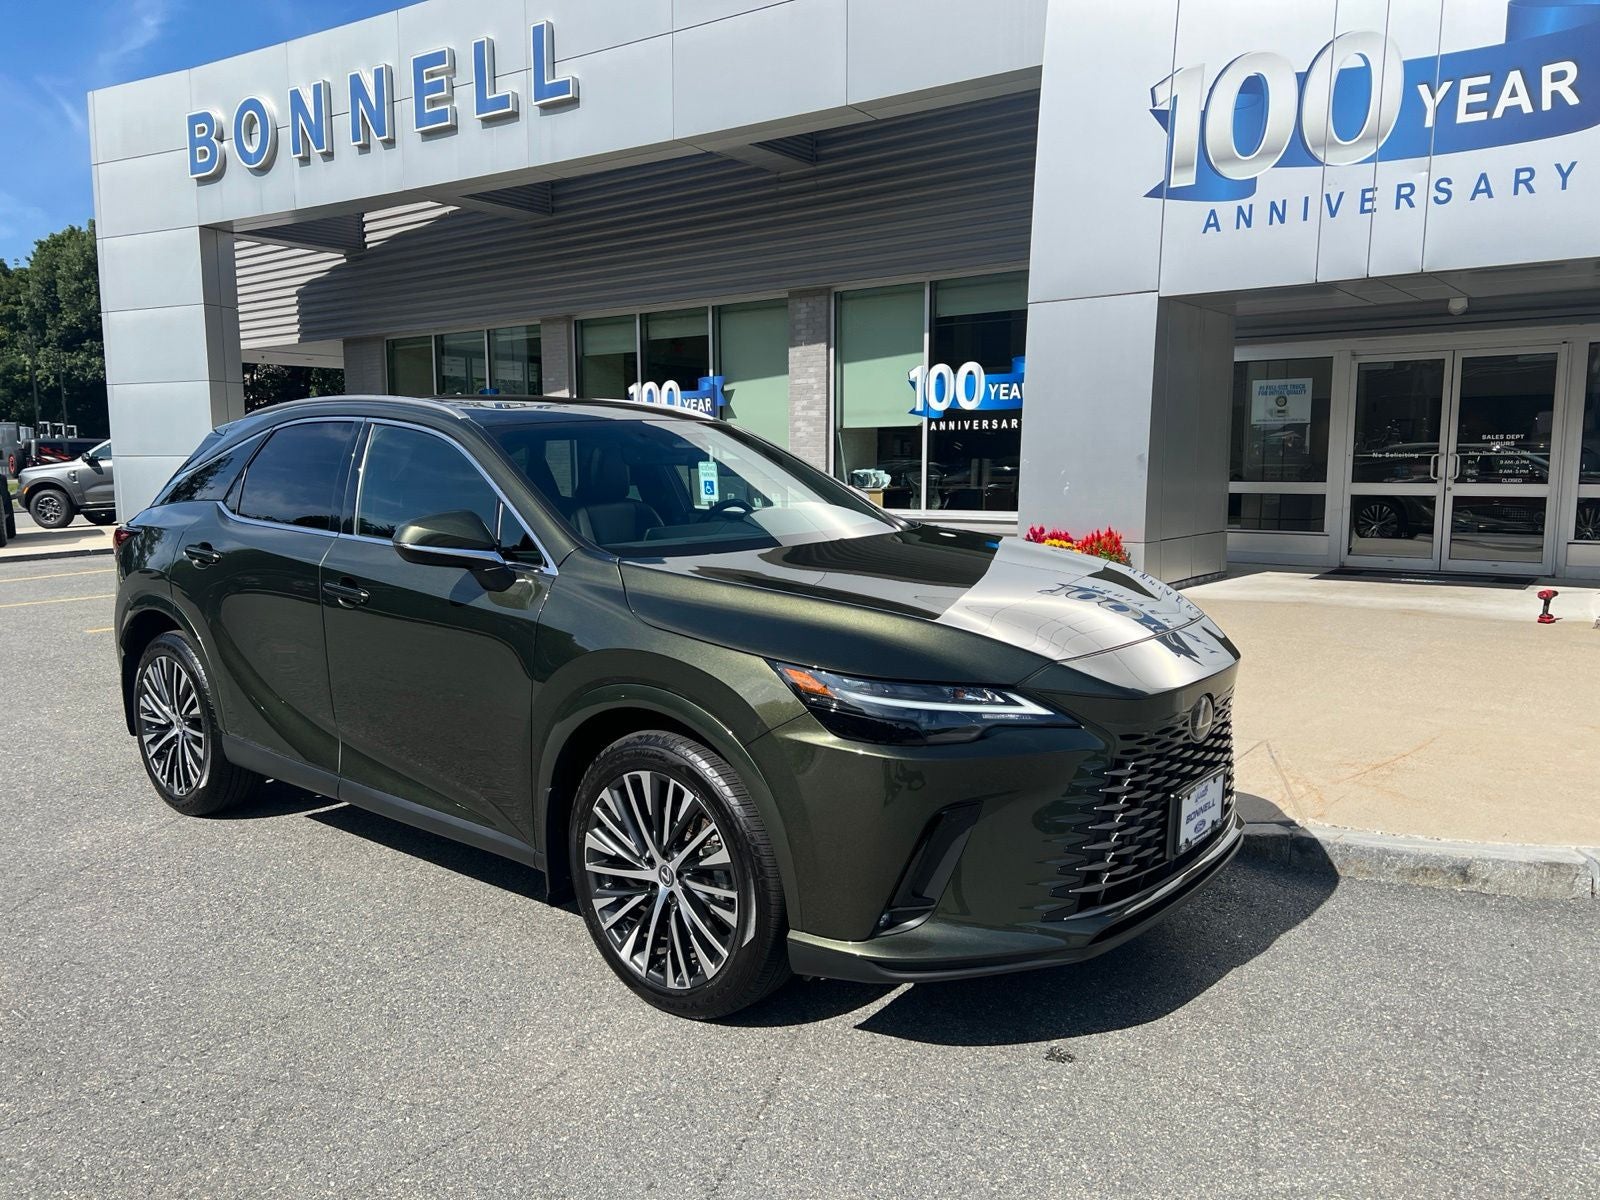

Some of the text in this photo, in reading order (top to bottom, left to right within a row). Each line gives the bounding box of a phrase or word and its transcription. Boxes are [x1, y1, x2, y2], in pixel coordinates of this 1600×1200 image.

[186, 20, 578, 179] BONNELL
[1151, 30, 1580, 188] 100 YEAR
[1202, 161, 1578, 234] ANNIVERSARY
[628, 380, 712, 412] 100 YEAR
[908, 361, 1025, 411] 100 YEA
[930, 418, 1023, 431] ANNIVERSAR
[1186, 797, 1216, 825] BONNELL
